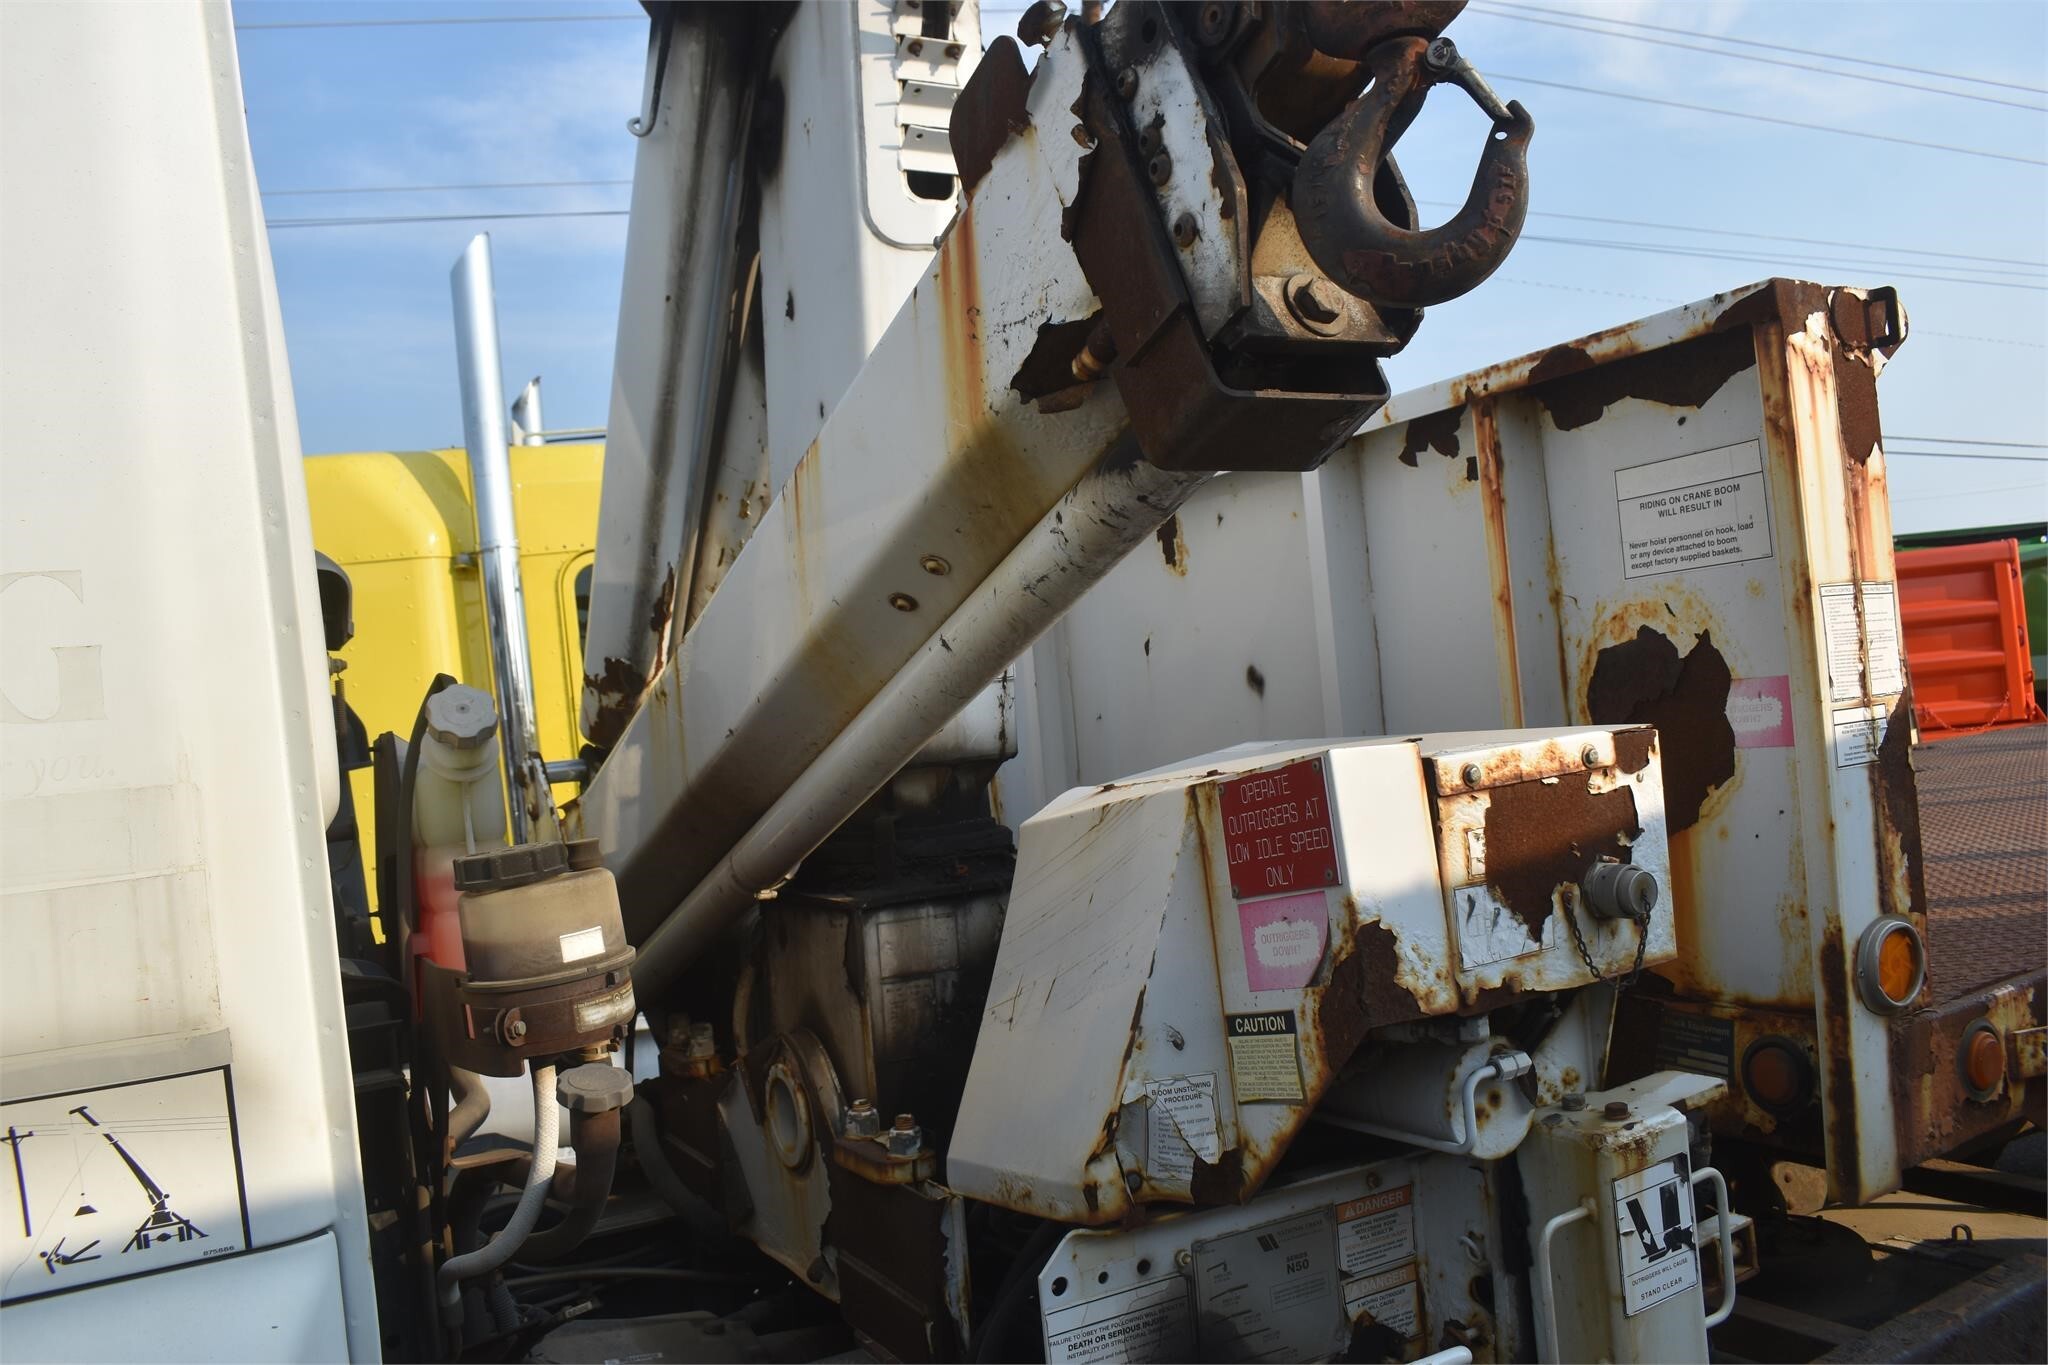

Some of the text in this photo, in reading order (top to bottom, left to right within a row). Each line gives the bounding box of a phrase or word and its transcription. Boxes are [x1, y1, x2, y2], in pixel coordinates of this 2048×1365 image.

[1640, 483, 1740, 511] RIDING ON CRANE BOOM
[1658, 499, 1722, 518] WILL RESULT IN
[1629, 541, 1648, 550] Never
[1650, 537, 1667, 546] hoist
[1669, 530, 1703, 545] personnel
[1715, 525, 1736, 534] hook,
[1737, 522, 1754, 531] load
[1639, 551, 1650, 559] any
[1652, 547, 1674, 557] device
[1676, 541, 1706, 552] attached
[1717, 537, 1737, 546] boom
[1631, 547, 1742, 571] except factory supplied baskets.
[1240, 773, 1291, 804] OPERATE
[1228, 797, 1319, 835] OUTRIGGERS AT
[1229, 827, 1330, 864] LOW IDLE SPEED
[1266, 863, 1295, 887] ONLY
[1235, 1016, 1286, 1033] CAUTION
[1151, 1081, 1211, 1096] BOOM UNSTOWING
[1164, 1092, 1202, 1104] PROCEDURE
[1356, 1191, 1404, 1212] DANGER
[1286, 1259, 1310, 1275] N50
[1631, 1257, 1688, 1287] OUTRIGGERS WILL CAUSE
[1360, 1269, 1408, 1292] DANGER
[1640, 1276, 1683, 1301] STAND CLEAR
[1050, 1337, 1073, 1347] FAILURE
[1082, 1329, 1098, 1339] OBEY
[1099, 1325, 1110, 1333] THE
[1110, 1315, 1144, 1329] FOLLOWING
[1068, 1338, 1093, 1352] DEATH
[1094, 1334, 1107, 1344] OR
[1107, 1323, 1141, 1340] SERIOUS
[1066, 1345, 1101, 1361] INSTABILITY
[1101, 1343, 1110, 1351] OR
[1110, 1331, 1147, 1348] STRUCTURAL
